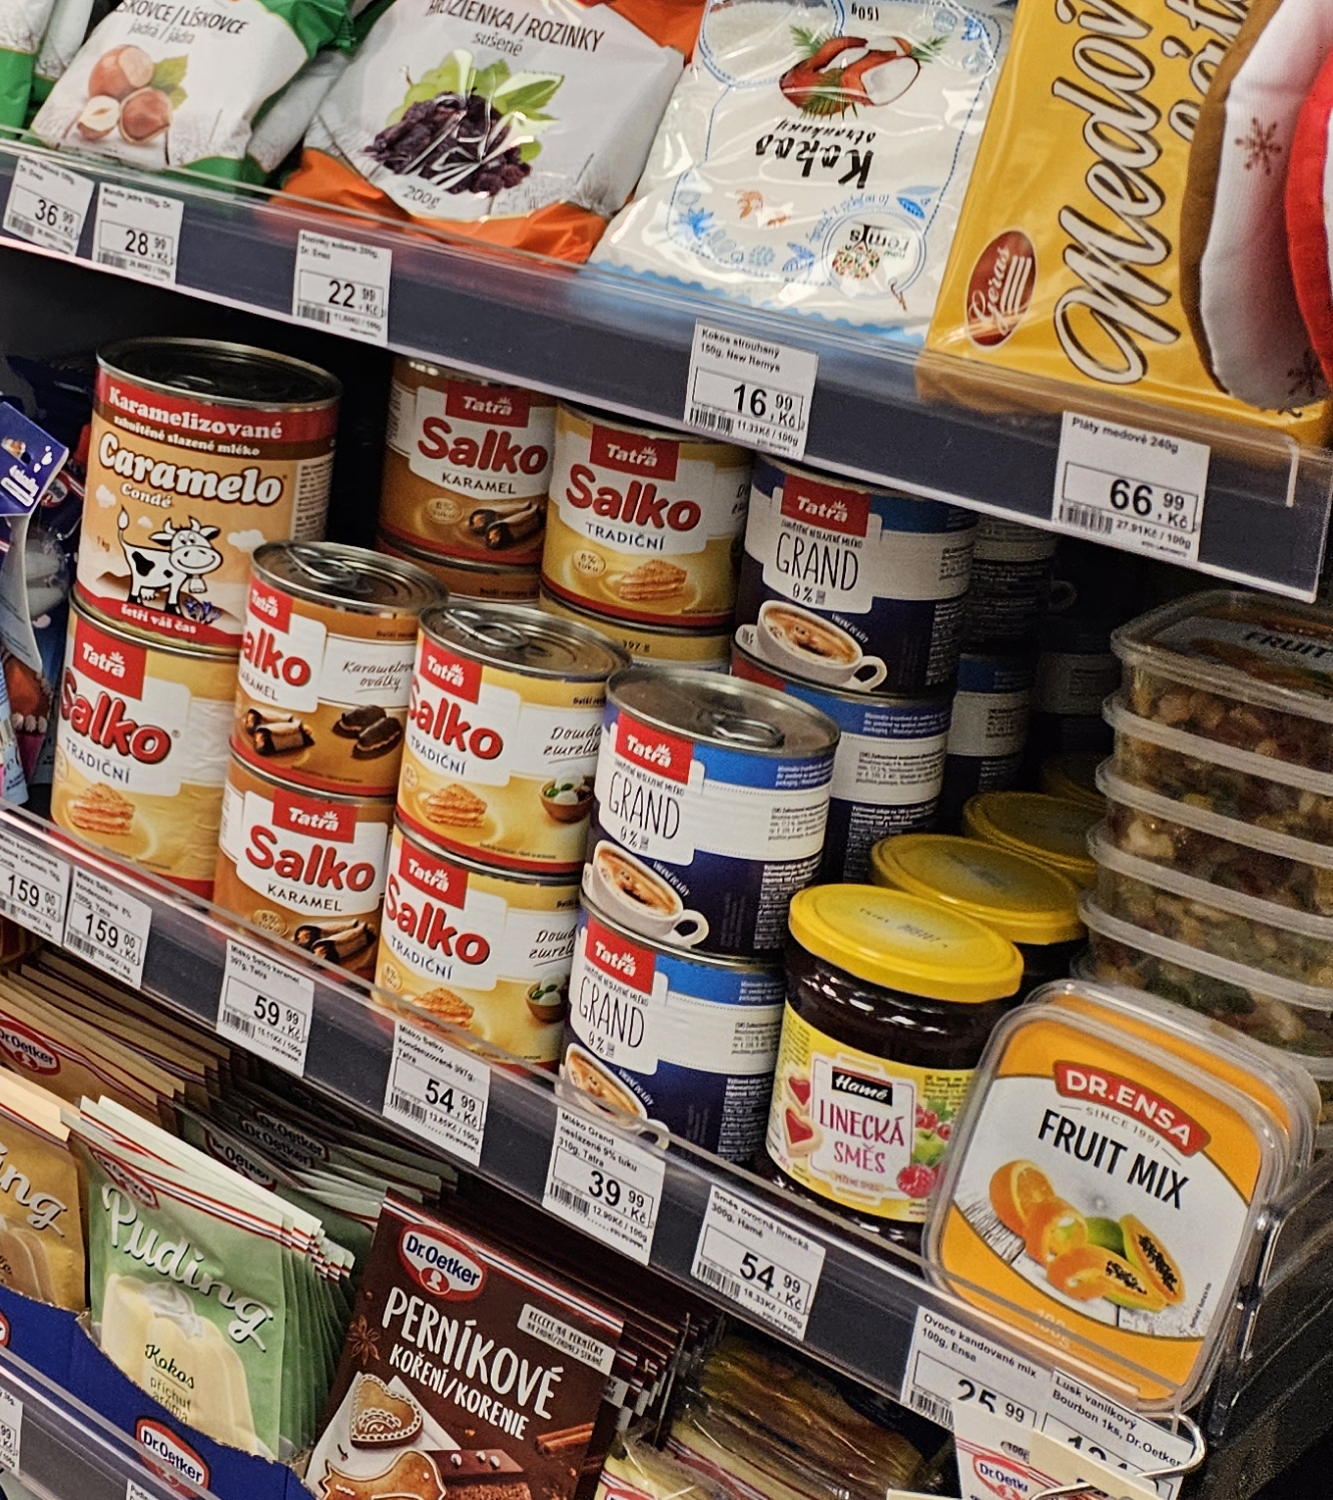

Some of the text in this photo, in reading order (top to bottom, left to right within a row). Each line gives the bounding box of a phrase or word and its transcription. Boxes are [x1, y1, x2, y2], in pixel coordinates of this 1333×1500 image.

[470, 29, 525, 57] sušené
[755, 133, 876, 190] Kokos
[401, 183, 443, 212] 200g
[701, 328, 781, 359] Kokos strouhaný
[108, 385, 284, 441] Karamelizované
[461, 395, 514, 417] Tatra
[166, 432, 261, 458] slazené mléko
[417, 415, 550, 477] Salko
[1071, 415, 1100, 436] Pláty
[1101, 424, 1149, 447] medové
[98, 431, 284, 506] Caramelo
[605, 442, 660, 469] Tatra
[119, 481, 174, 510] Condé
[440, 471, 518, 496] KARAMEL
[565, 461, 703, 532] Salko
[795, 493, 850, 524] Tatra
[585, 520, 666, 553] TRADIČNÍ
[774, 531, 861, 593] GRAND
[120, 603, 198, 635] šetří váš čas
[81, 641, 127, 680] Tatra
[425, 653, 466, 688] Tatra
[58, 667, 172, 765] Salko
[409, 680, 505, 765] Salko
[64, 735, 133, 786] TRADIČNÍ
[625, 734, 673, 769] Tatra
[287, 805, 341, 832] Tatra
[608, 772, 682, 840] GRAND
[244, 823, 378, 893] Salko
[407, 856, 451, 894] Tatra
[266, 883, 344, 913] KARAMEL
[385, 872, 491, 966] Salko
[389, 934, 454, 981] TRADIČNÍ
[594, 937, 637, 979] Tatra
[578, 976, 646, 1050] GRAND
[834, 1074, 889, 1100] Hamé
[1064, 1068, 1192, 1145] DR.ENSA
[587, 1124, 615, 1147] Grand
[819, 1098, 906, 1147] LINECKÁ
[1085, 1106, 1163, 1149] SINCE 1991
[833, 1140, 886, 1174] SMĚS
[1037, 1107, 1192, 1211] FRUIT MIX
[737, 1217, 765, 1240] Hamé
[739, 1204, 810, 1252] ovocná linecká
[101, 1180, 275, 1354] Puding
[405, 1233, 481, 1288] Dr.Oetker
[144, 1342, 197, 1390] Kokos
[381, 1285, 565, 1421] PERNÍKOVÉ
[922, 1313, 1038, 1379] Ovoce kandované mix
[950, 1340, 977, 1363] Ensa
[389, 1342, 531, 1442] KOŘENÍ/KORENIE
[1051, 1389, 1100, 1426] Bourbon
[1054, 1375, 1138, 1431] Lusk vanilkový
[142, 1428, 205, 1484] Dr.Oetker
